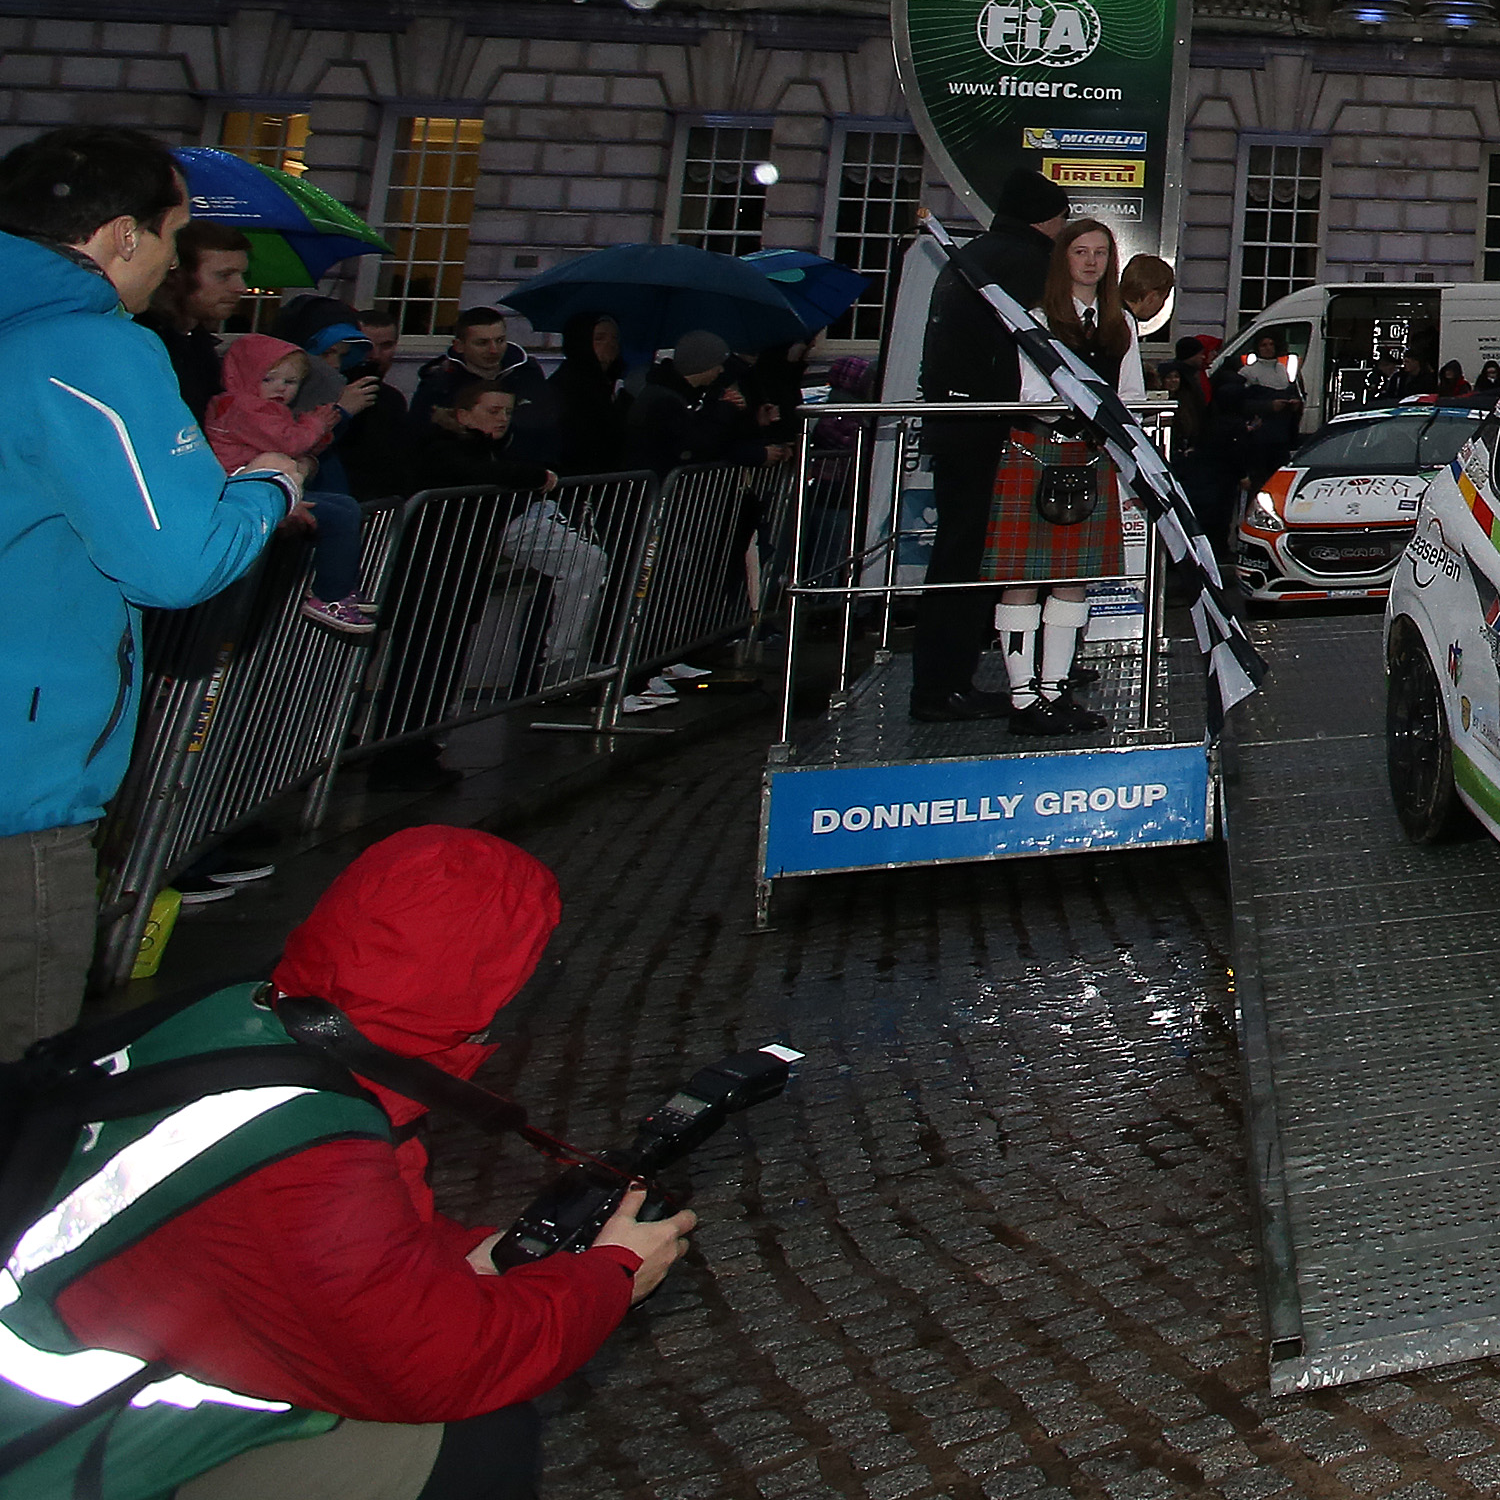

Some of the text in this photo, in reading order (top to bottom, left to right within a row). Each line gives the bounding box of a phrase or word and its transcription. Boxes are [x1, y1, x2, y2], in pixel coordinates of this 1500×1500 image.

[949, 76, 1122, 100] www.fiaerc.com
[1061, 133, 1144, 146] MICHELIN
[1052, 163, 1136, 183] PIRELLI
[812, 783, 1168, 834] DONNELLY GROUP
